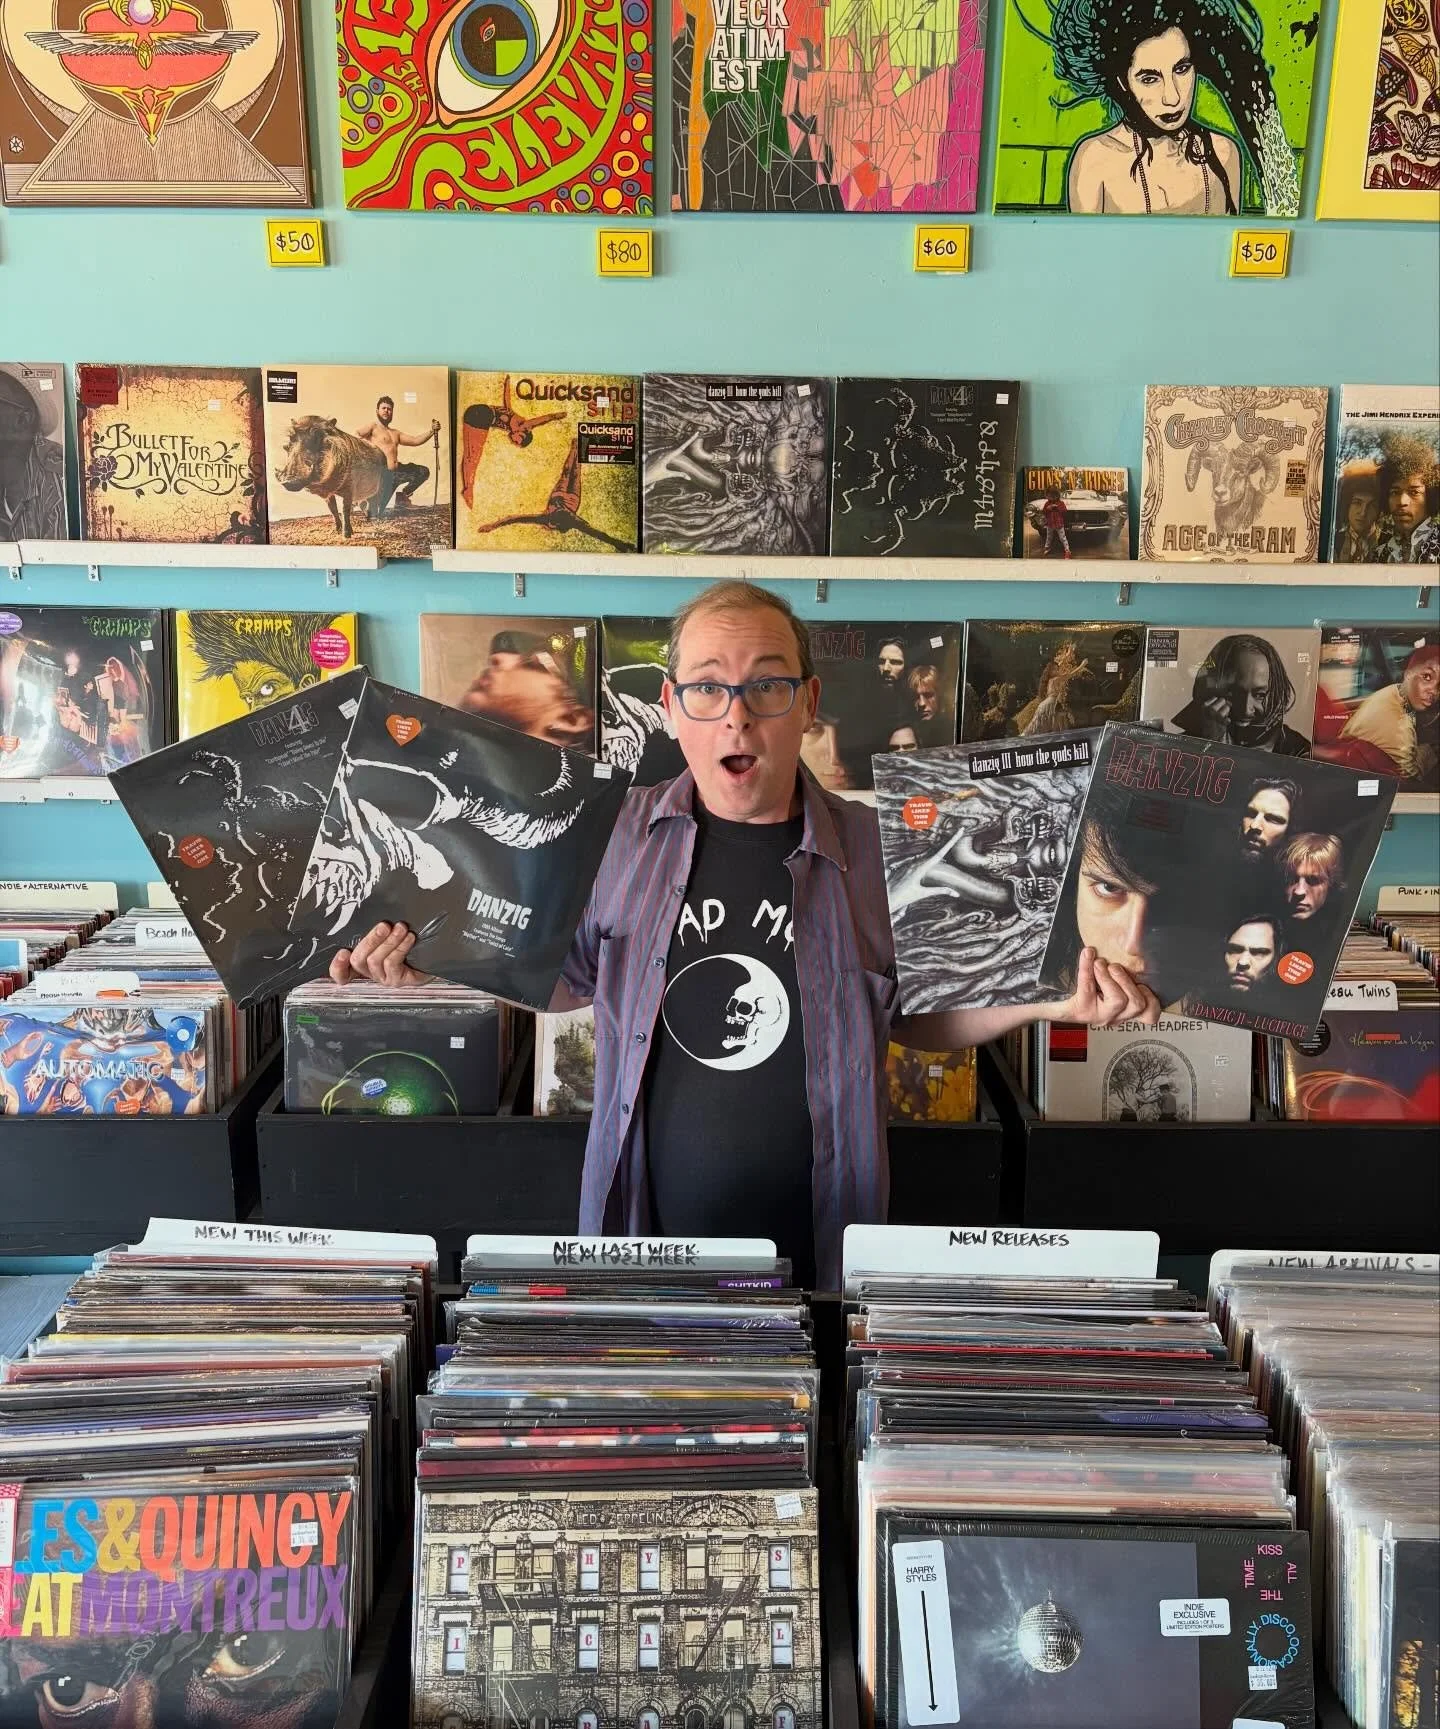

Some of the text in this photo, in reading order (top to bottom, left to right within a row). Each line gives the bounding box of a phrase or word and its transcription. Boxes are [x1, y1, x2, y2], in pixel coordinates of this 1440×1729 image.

[711, 0, 789, 28] VECK
[709, 28, 785, 60] ATIM
[711, 60, 762, 92] EST
[275, 230, 314, 254] $50
[606, 240, 642, 264] $80
[922, 237, 958, 258] $60
[1240, 240, 1278, 264] $50
[516, 379, 634, 402] Quicksand
[579, 424, 633, 435] Quicksand
[1028, 470, 1061, 491] GUNS
[1085, 470, 1124, 491] ROSES
[1162, 523, 1296, 553] AGE OF THE RAM
[90, 616, 152, 637] CRAMPS
[234, 617, 293, 636] CRAMPS
[972, 742, 1089, 774] danzig III how the gods kill
[1105, 736, 1234, 803] DANZIG
[1398, 887, 1422, 896] PUNK
[467, 888, 532, 930] DANZIG
[145, 927, 178, 939] Beach
[1358, 984, 1390, 998] Twins
[1194, 1003, 1236, 1021] DANZIG
[1117, 1021, 1146, 1032] SEAT
[1151, 1021, 1209, 1032] HEADREST
[194, 1225, 334, 1246] NEW THIS WEEK
[949, 1230, 1070, 1247] NEW RELEASES
[553, 1240, 597, 1257] NEW
[601, 1241, 645, 1257] LAST
[1267, 1256, 1315, 1268] NEW
[1325, 1255, 1416, 1272] ARRIVALS
[608, 1512, 666, 1525] ZEPPELIN
[140, 1491, 350, 1583] QUINCY
[1257, 1544, 1283, 1556] KISS
[905, 1574, 937, 1583] STYLES
[906, 1565, 934, 1574] HARRY
[1287, 1562, 1297, 1584] ALL
[1260, 1589, 1283, 1601] THE
[1173, 1610, 1216, 1618] EXCLUSIVE
[1184, 1603, 1204, 1611] INDIE
